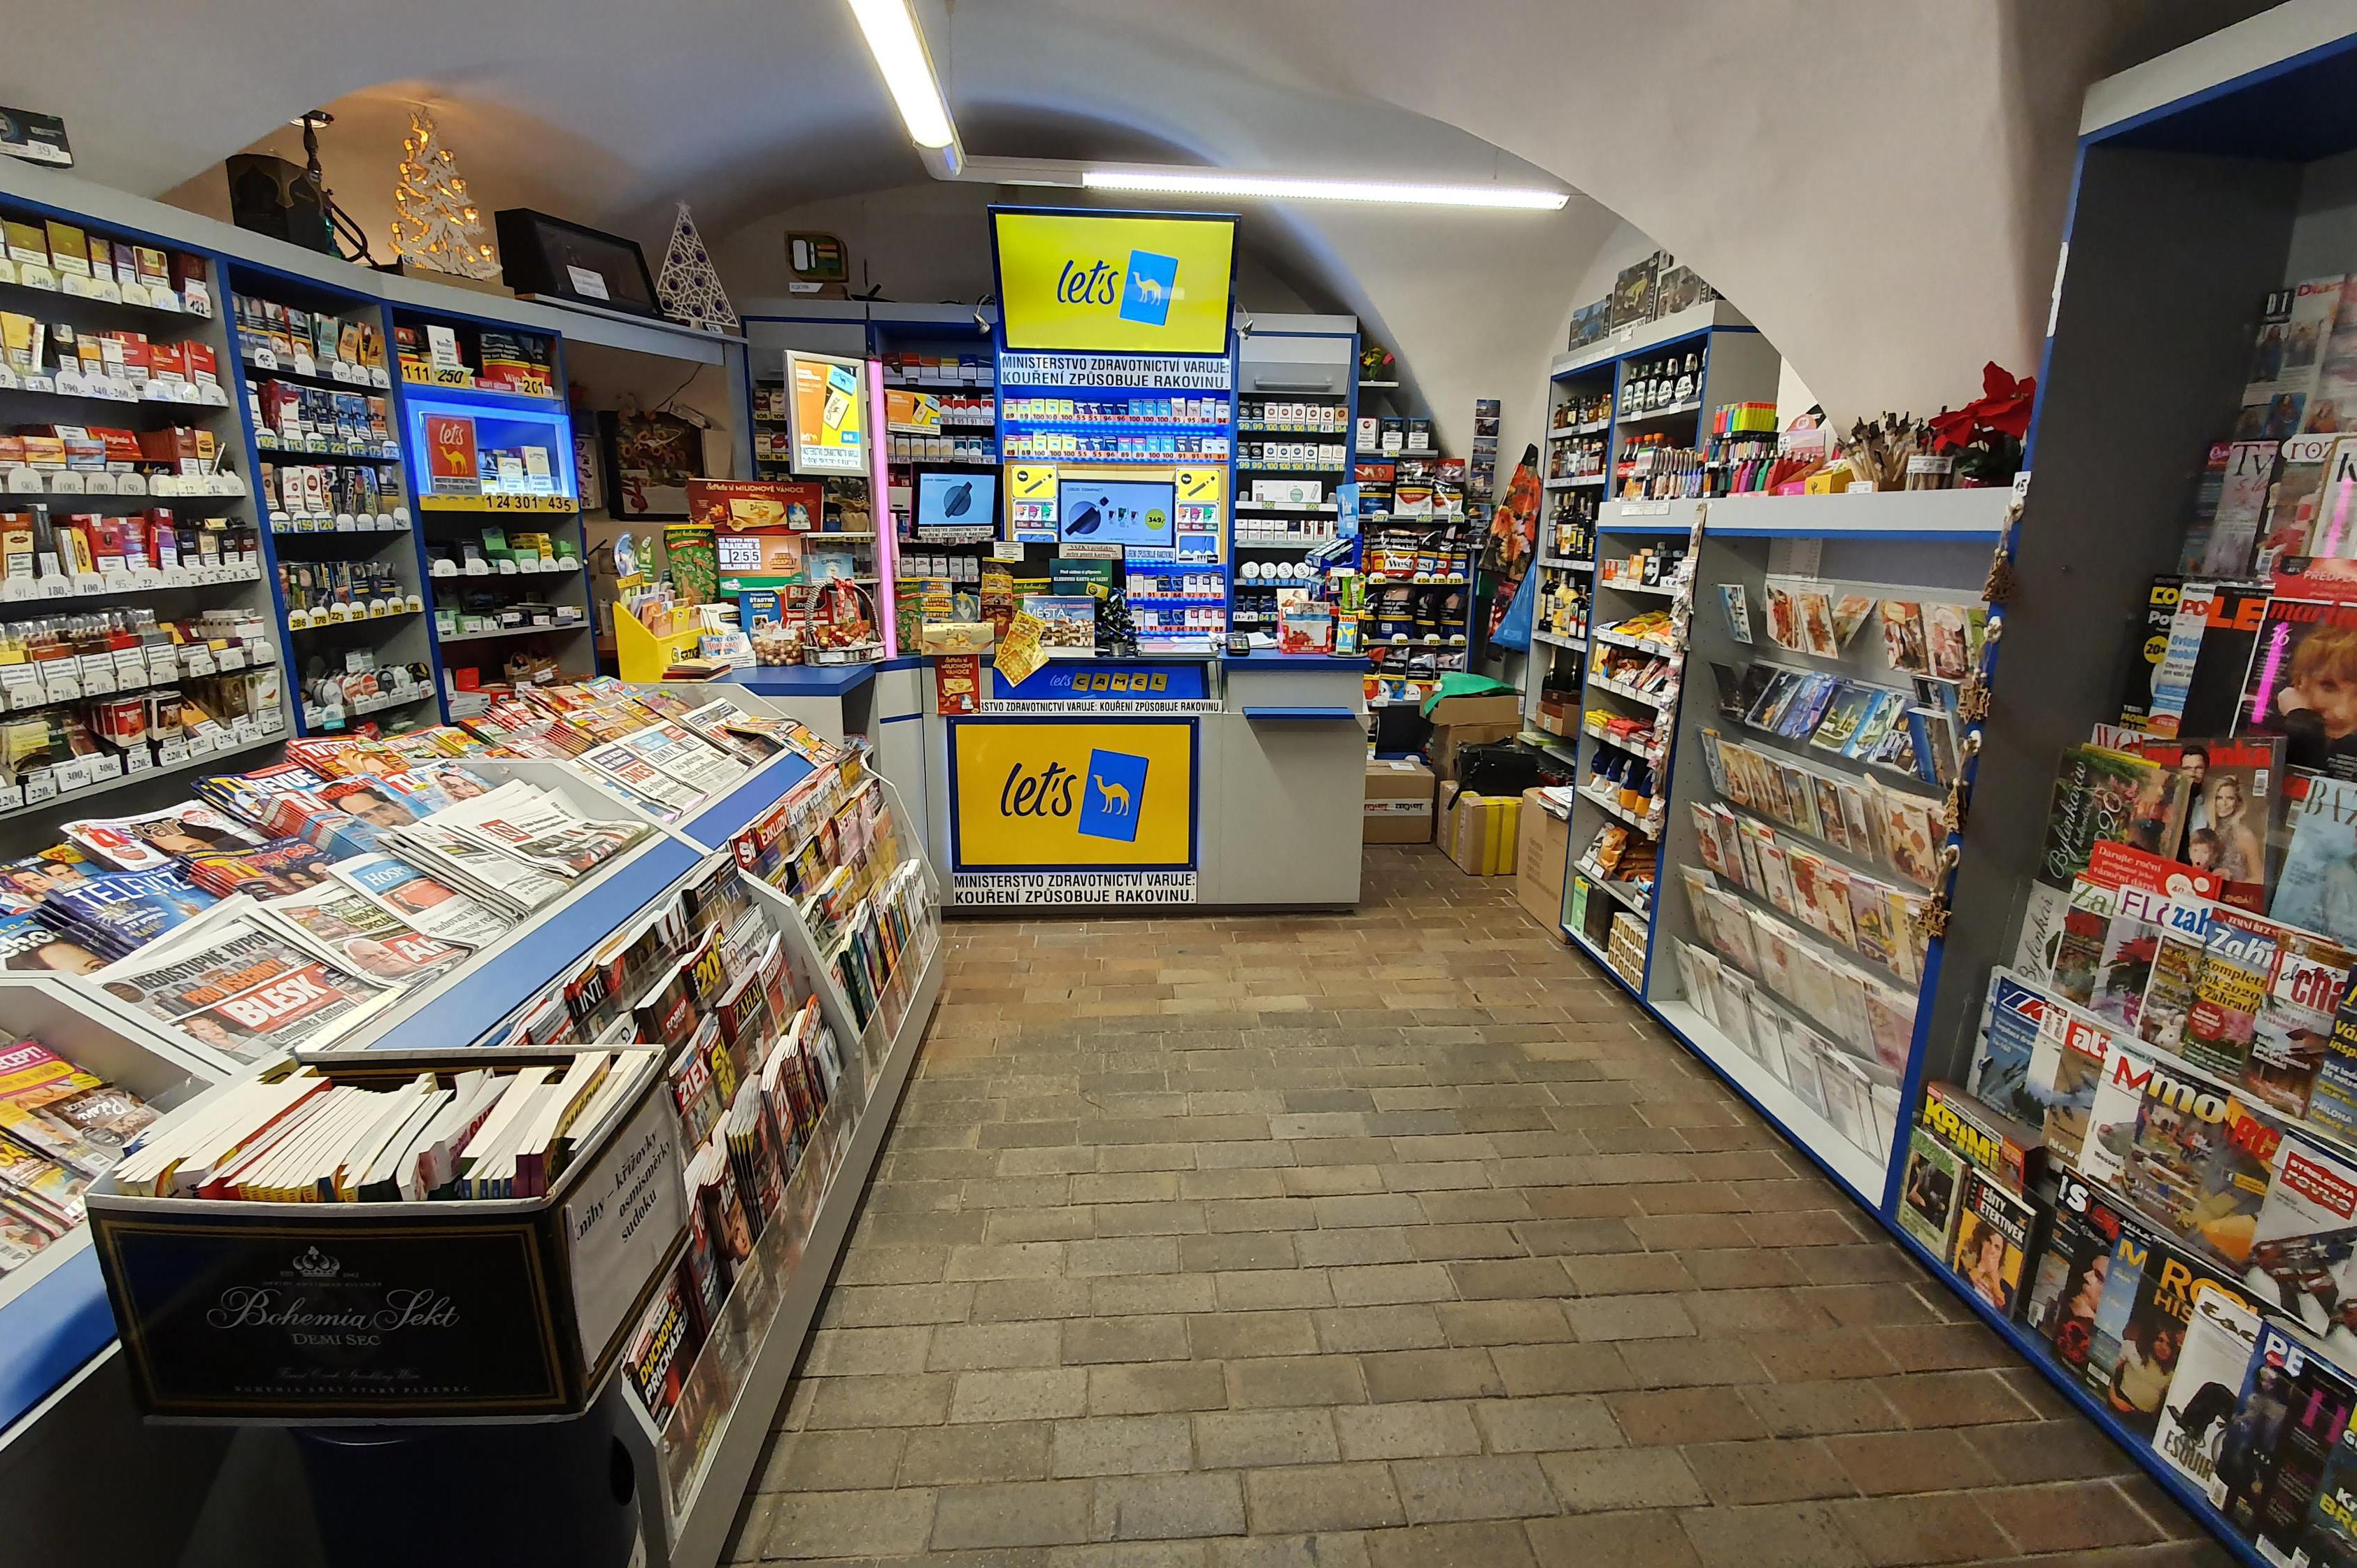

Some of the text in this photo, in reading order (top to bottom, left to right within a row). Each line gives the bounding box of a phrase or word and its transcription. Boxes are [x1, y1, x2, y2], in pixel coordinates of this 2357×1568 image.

[1057, 259, 1119, 305] let's
[437, 369, 463, 384] 250
[1002, 356, 1230, 374] MINISTERSTVO ZDRAVOTNICTVÍ VARUJE:
[523, 380, 544, 394] 201
[1002, 370, 1229, 388] KOUŘENÍ ZPŮSOBUJE RAKOVINU.
[439, 422, 464, 445] let's
[515, 497, 571, 511] 301 435
[1026, 606, 1066, 618] MĚSTA
[1050, 673, 1071, 688] let's
[1006, 700, 1065, 713] ZDRAVOTNICTVÍ
[1067, 701, 1098, 712] VARUJE:
[1100, 700, 1134, 712] KOUŘENÍ
[1135, 700, 1179, 712] ZPŮSOBUJE
[1181, 701, 1221, 712] RAKOVINU.
[208, 767, 322, 794] TV REVUE
[620, 763, 656, 785] DNES
[278, 789, 329, 812] TV
[1000, 761, 1077, 817] let's
[124, 817, 185, 840] star
[954, 870, 1196, 888] MINISTERSTVO ZDRAVOTNICTVÍ VARUJE:
[955, 887, 1195, 904] KOUŘENÍ ZPŮSOBUJE RAKOVINU.
[136, 946, 230, 991] NEDOSTUPNÉ
[223, 974, 322, 1028] BLESK
[576, 1129, 658, 1241] nihy křížovky
[1978, 1185, 2007, 1213] EŠITY
[621, 1190, 657, 1244] sudoku
[1975, 1197, 2025, 1244] ETEKTIVEK
[206, 1285, 461, 1332] Bohemia Sekt
[291, 1332, 381, 1346] DEMI SEC
